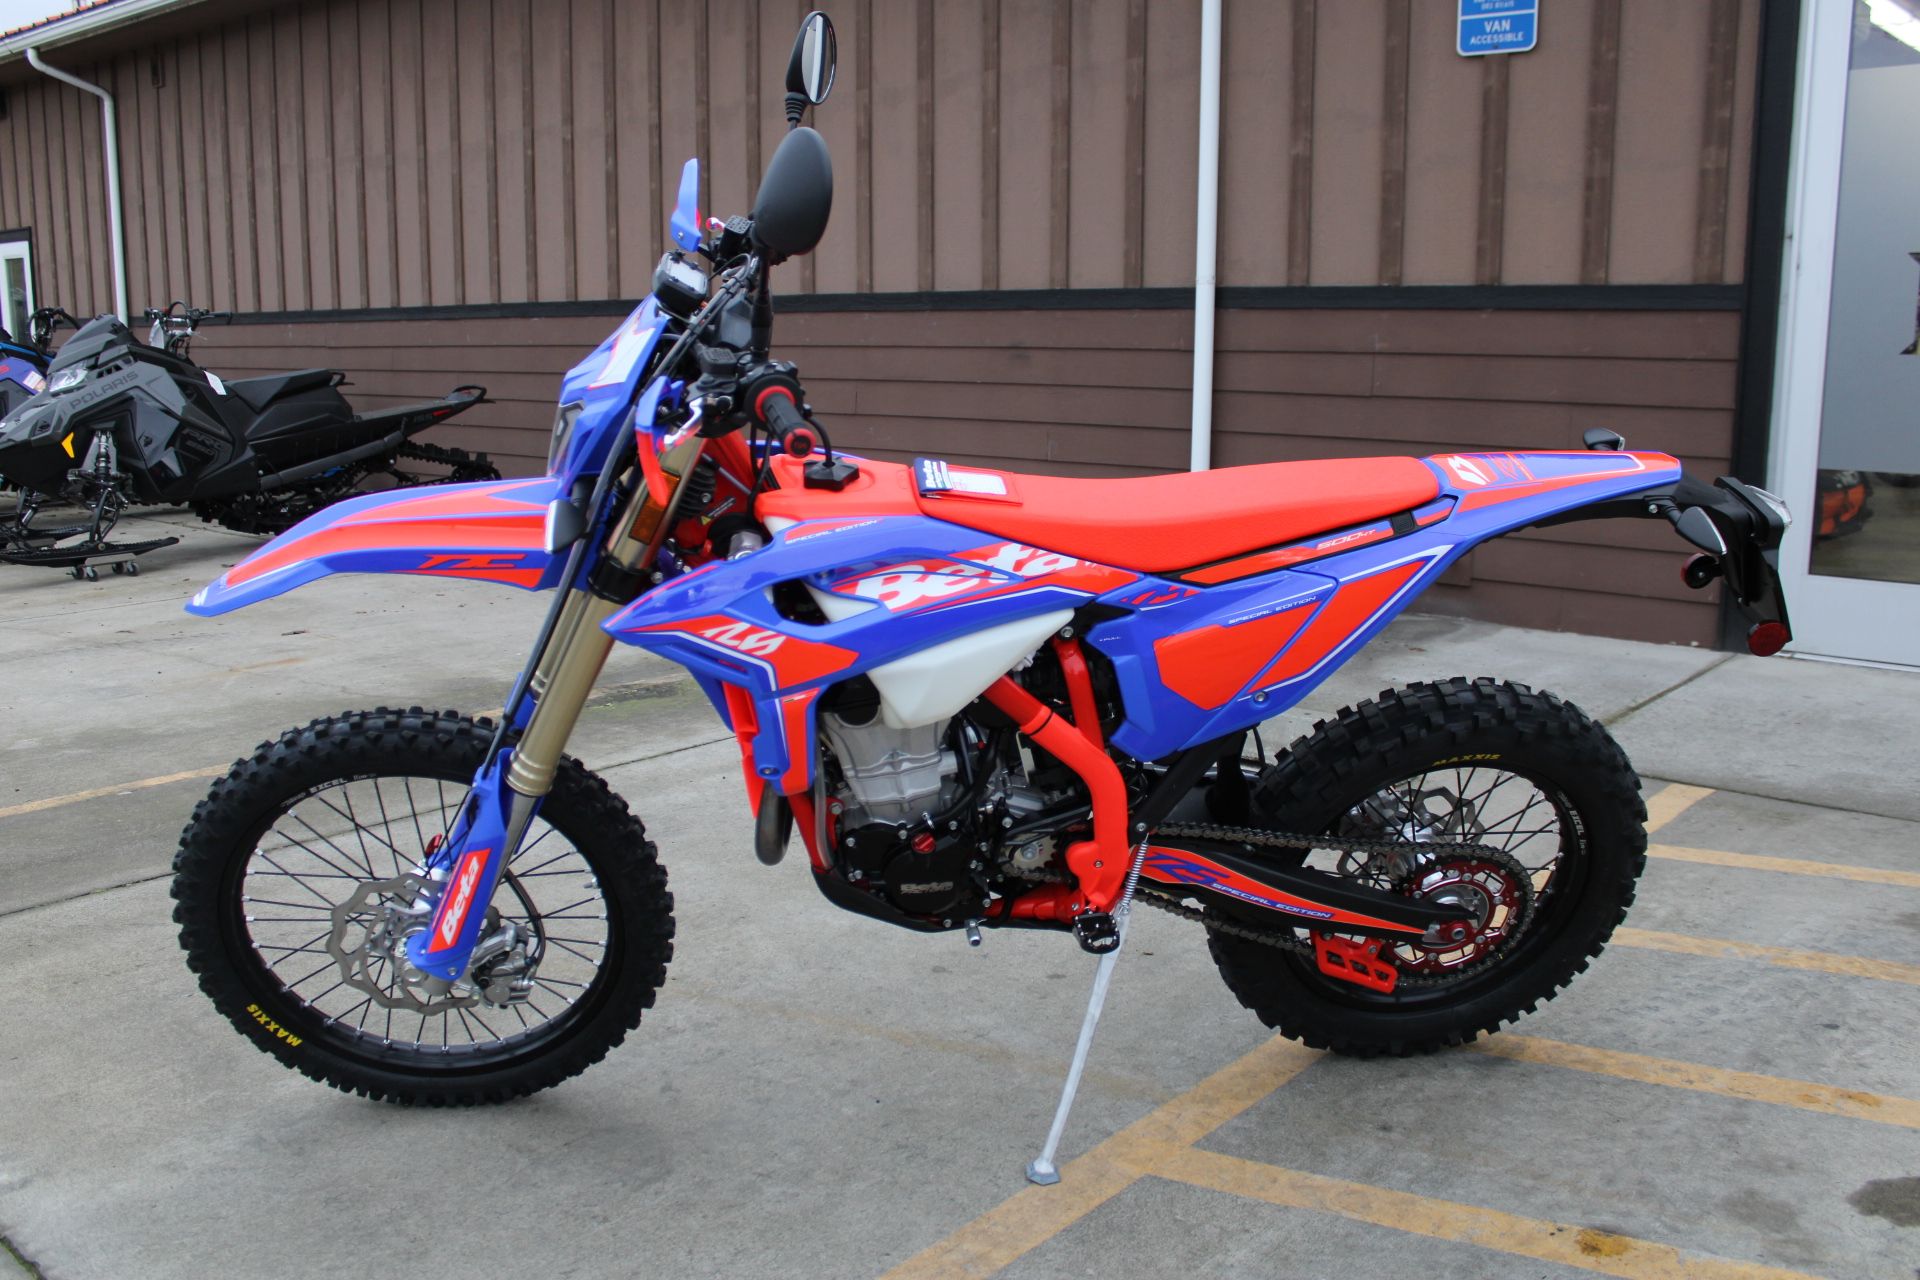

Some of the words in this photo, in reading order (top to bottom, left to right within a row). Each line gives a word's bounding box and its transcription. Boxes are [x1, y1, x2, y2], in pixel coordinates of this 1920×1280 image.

[1470, 32, 1524, 46] ACCESSIBLE
[1484, 19, 1511, 33] VAN
[70, 371, 139, 410] POLARIS
[785, 530, 833, 545] SPECIAL
[835, 520, 878, 533] EDITION
[855, 541, 1079, 614] Beta
[1228, 609, 1273, 625] SPECIAL
[1275, 595, 1317, 612] EDITION
[1432, 754, 1501, 767] MAXXIS
[1569, 810, 1586, 836] EXCEL
[441, 855, 480, 946] Beta
[1211, 882, 1272, 906] SPECIAL
[1275, 902, 1332, 919] EDITION
[246, 1003, 303, 1047] MAXXIS
